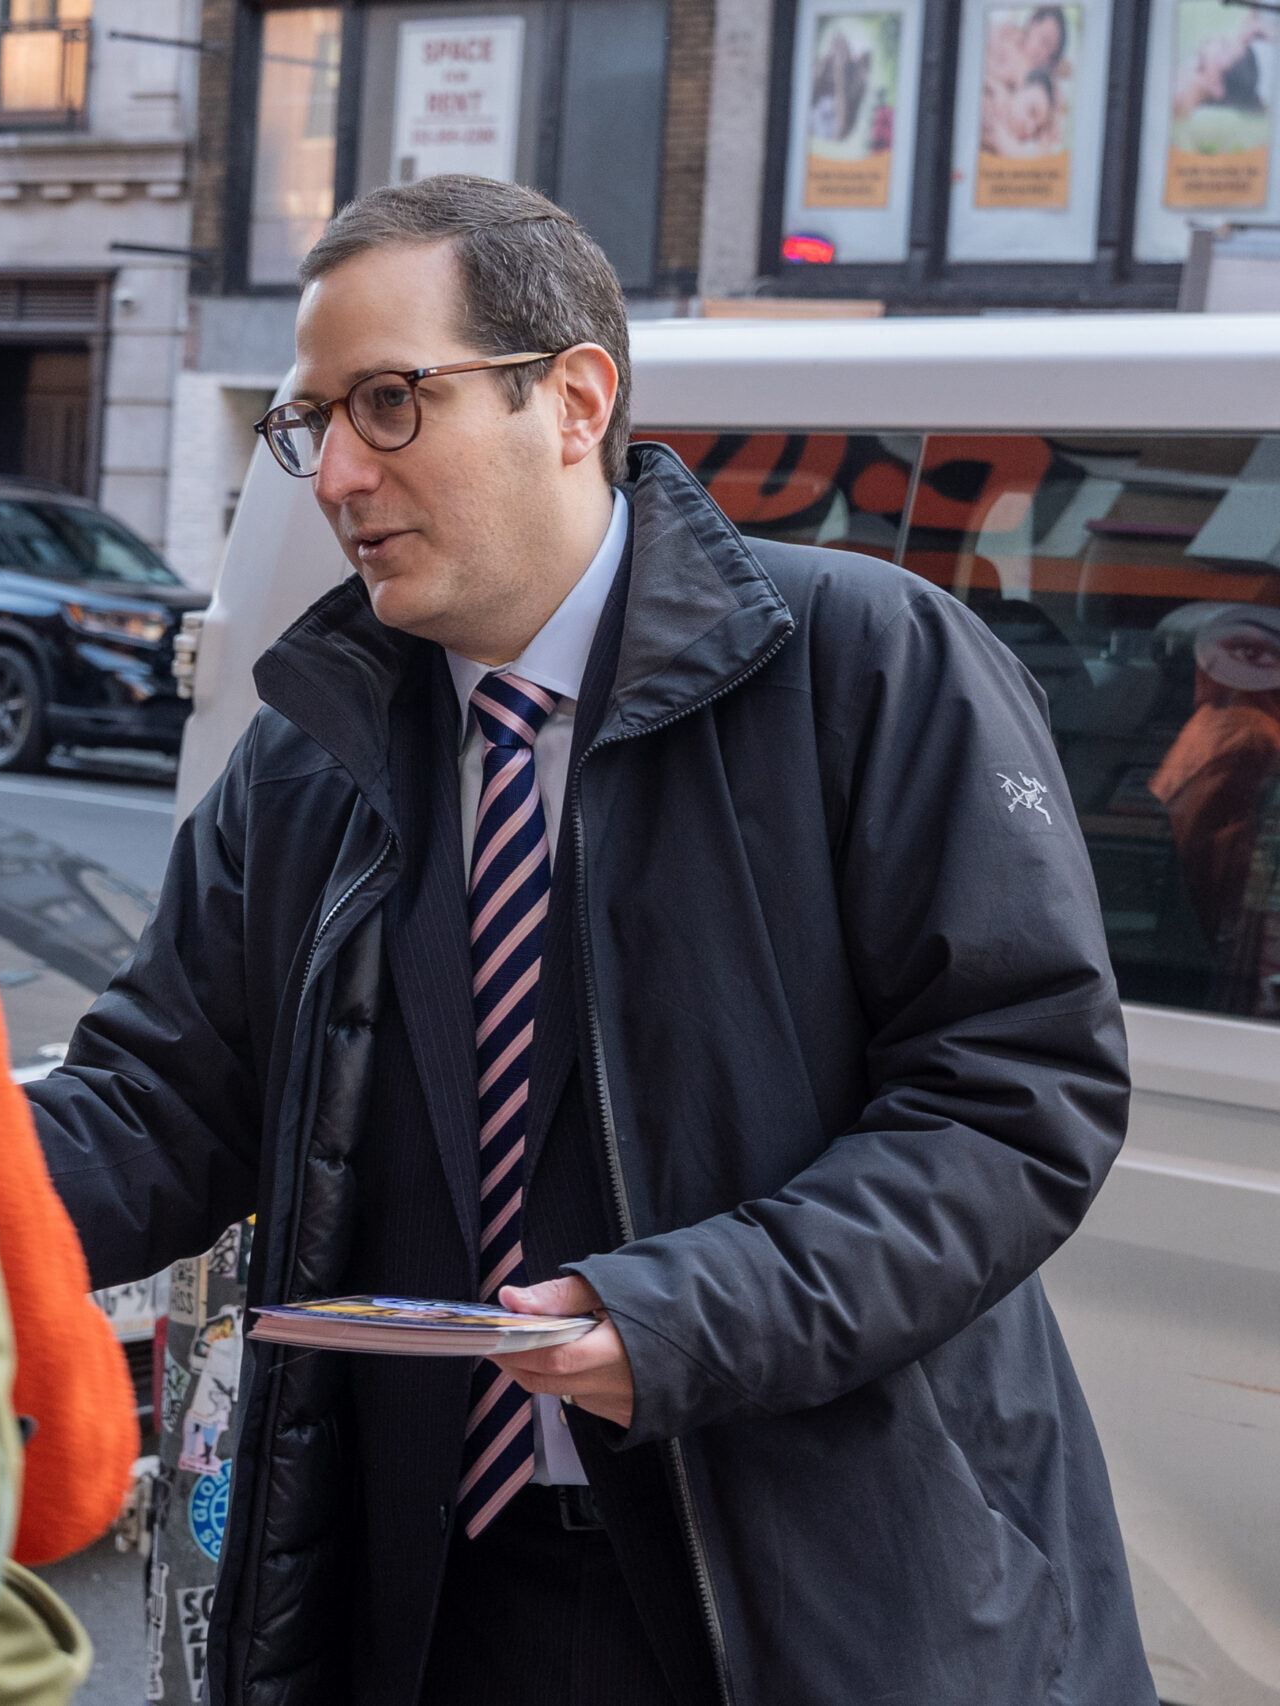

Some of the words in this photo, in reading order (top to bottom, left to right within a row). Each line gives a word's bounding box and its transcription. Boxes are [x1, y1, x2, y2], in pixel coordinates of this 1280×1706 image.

[424, 37, 494, 64] SPACE
[426, 90, 483, 114] RENT
[192, 1463, 232, 1523] GLOB
